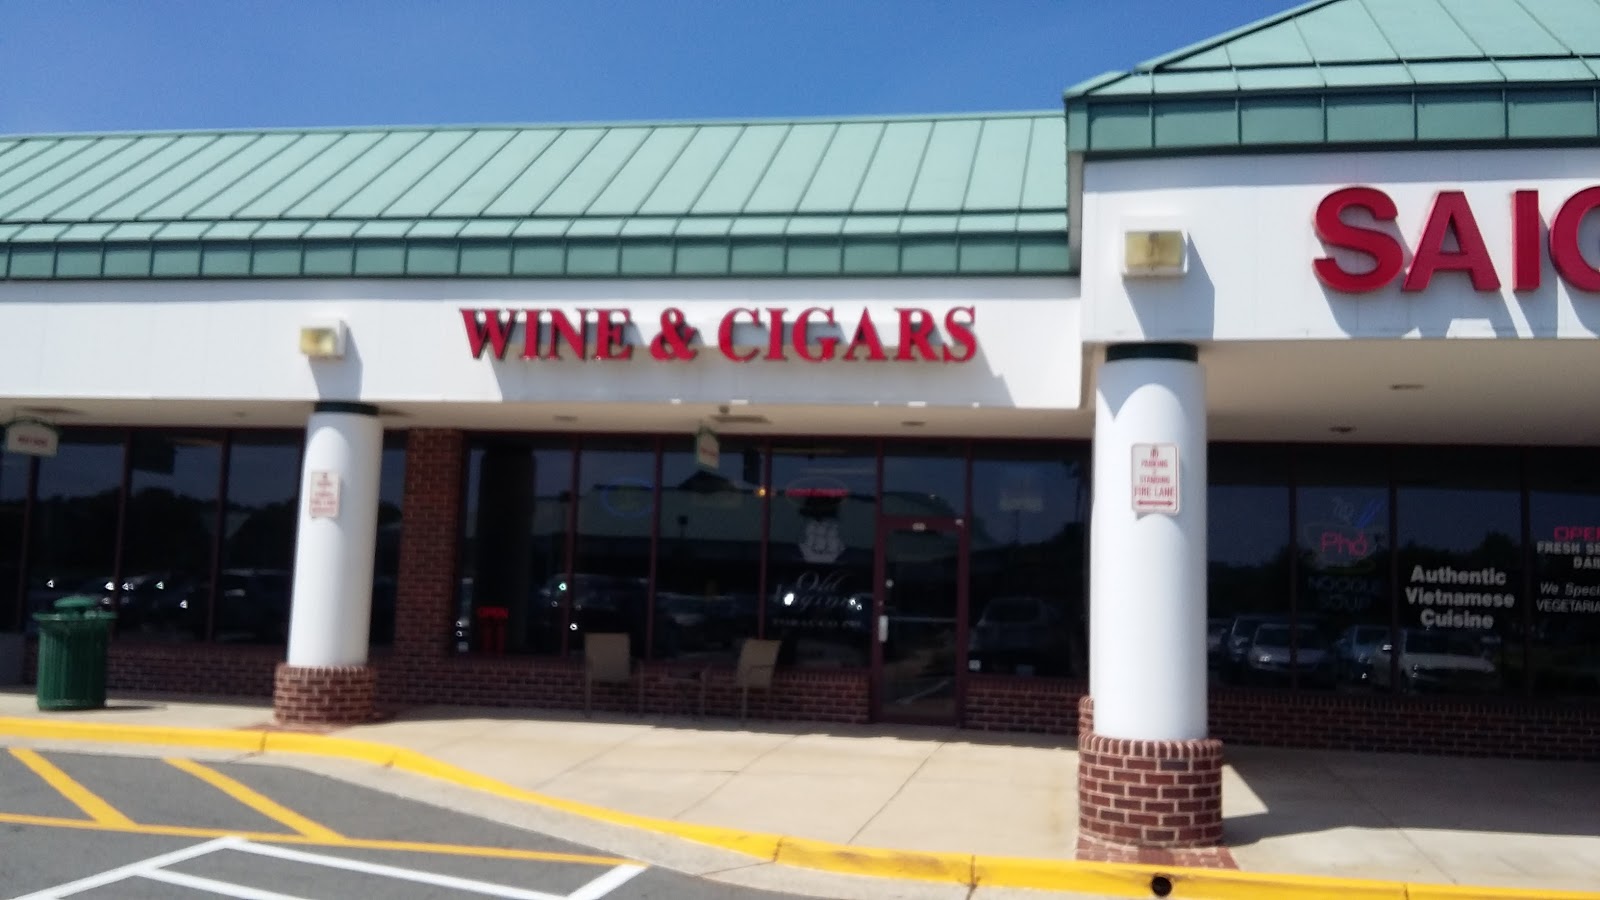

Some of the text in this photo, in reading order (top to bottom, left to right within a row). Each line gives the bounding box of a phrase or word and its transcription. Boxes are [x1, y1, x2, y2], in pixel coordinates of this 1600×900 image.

[458, 306, 978, 363] WINE & CIGARS
[1141, 459, 1168, 468] PARKING
[1154, 486, 1174, 497] LANE
[1537, 541, 1580, 555] FRESH
[1410, 564, 1507, 586] Authentic
[1405, 586, 1516, 608] Vietnamese
[1540, 581, 1560, 596] We
[1420, 608, 1495, 630] Cuisine
